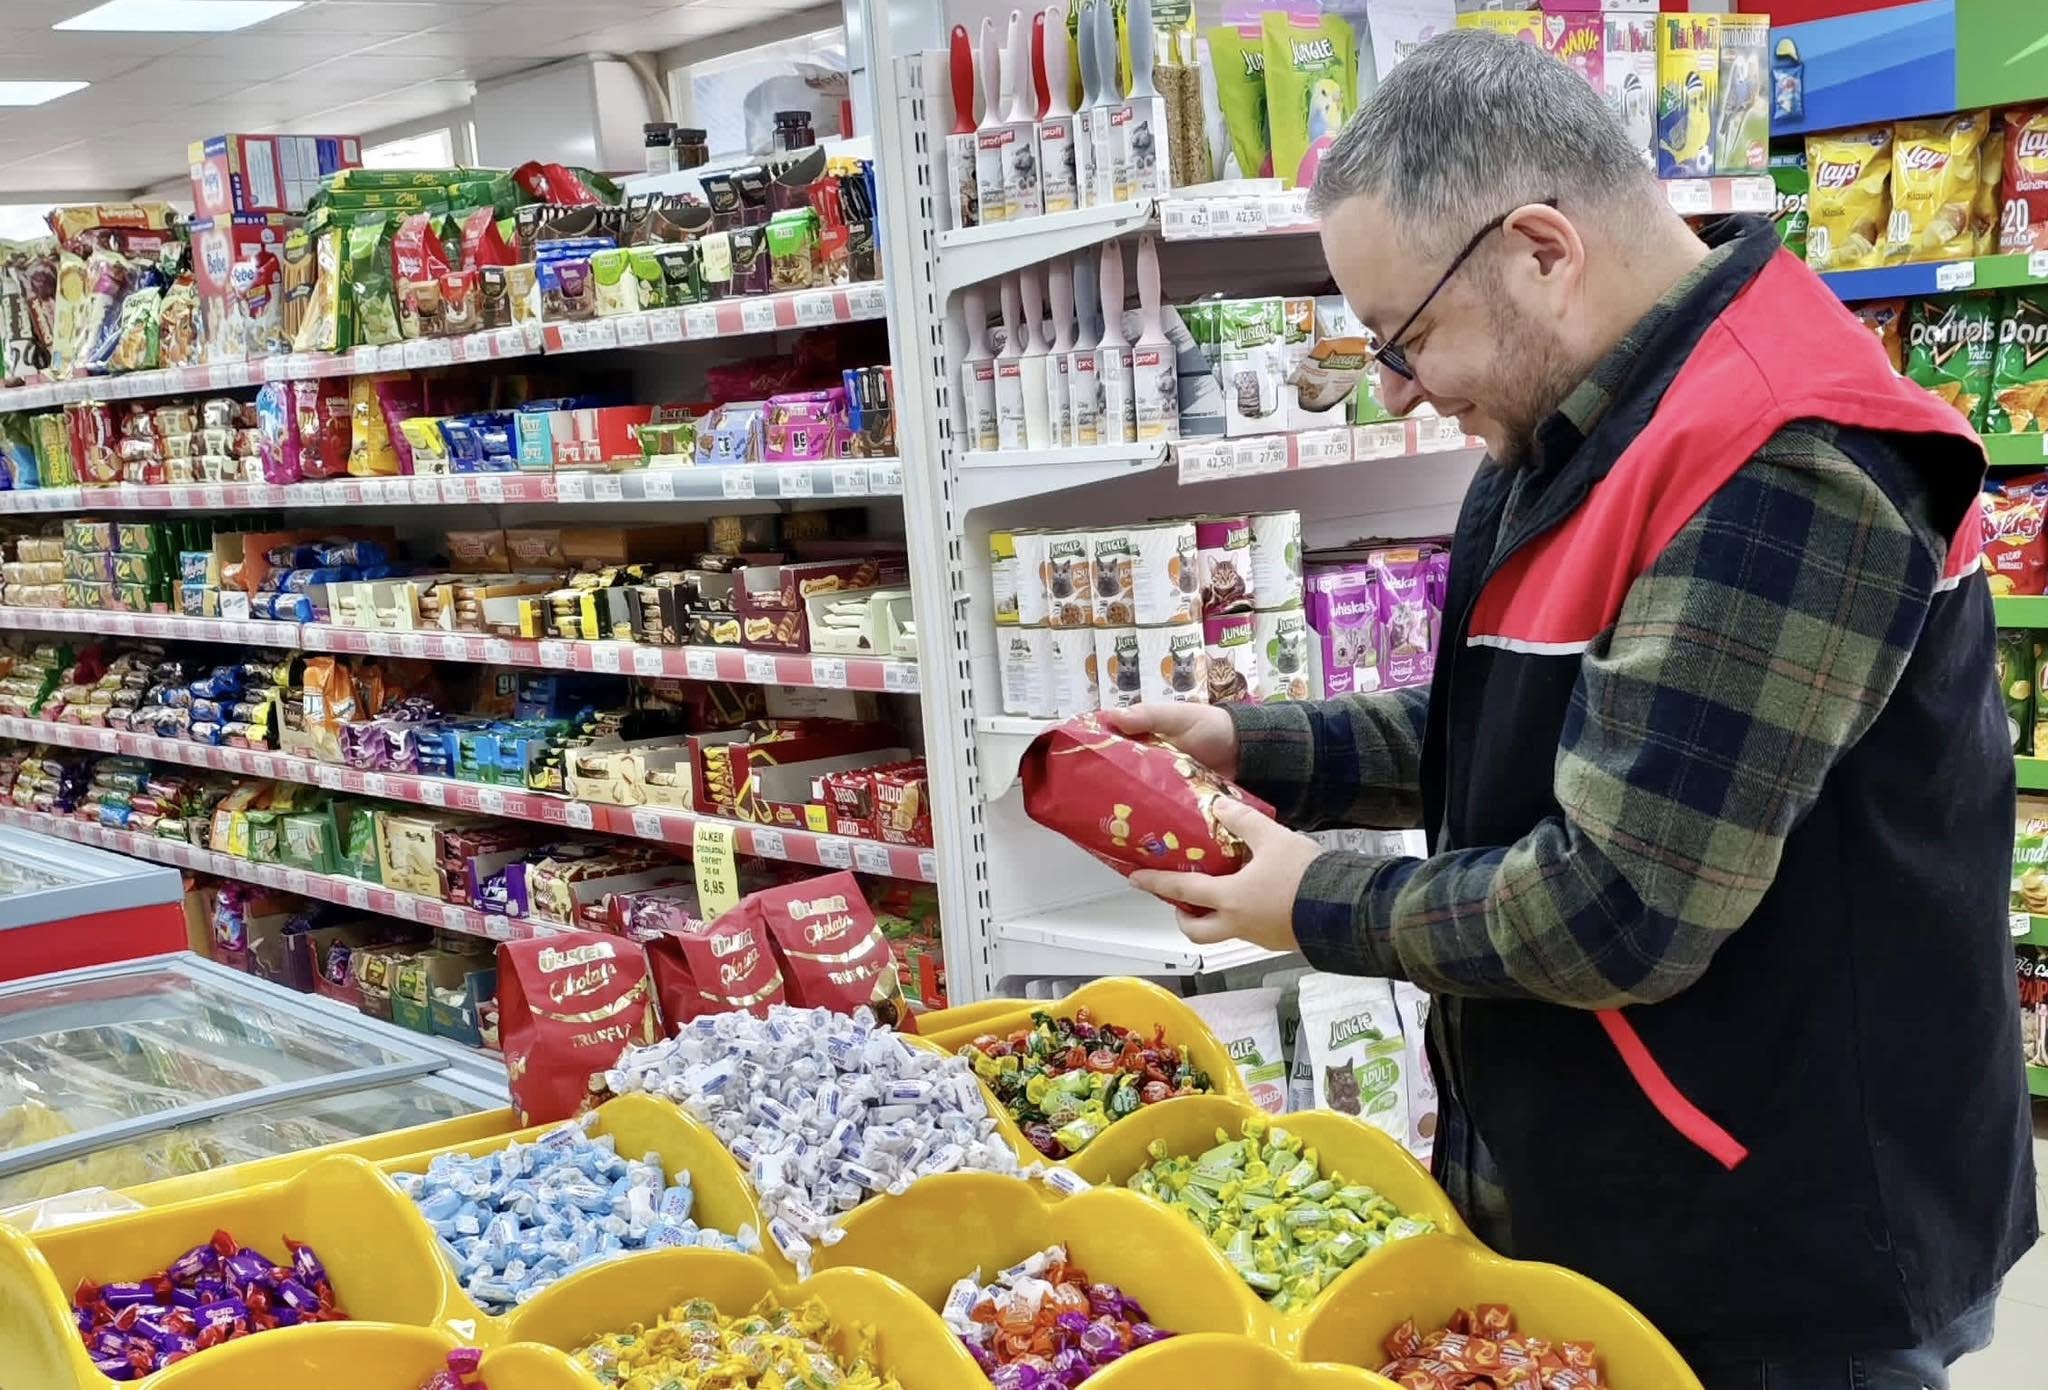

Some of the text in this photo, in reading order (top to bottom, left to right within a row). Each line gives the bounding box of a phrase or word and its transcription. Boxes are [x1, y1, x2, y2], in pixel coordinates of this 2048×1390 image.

[1289, 37, 1335, 65] JUNGLE
[1910, 321, 1995, 347] Doritos
[703, 878, 725, 896] 8,95
[1329, 1012, 1375, 1048] JUNGLE
[1361, 1063, 1395, 1087] ADULT
